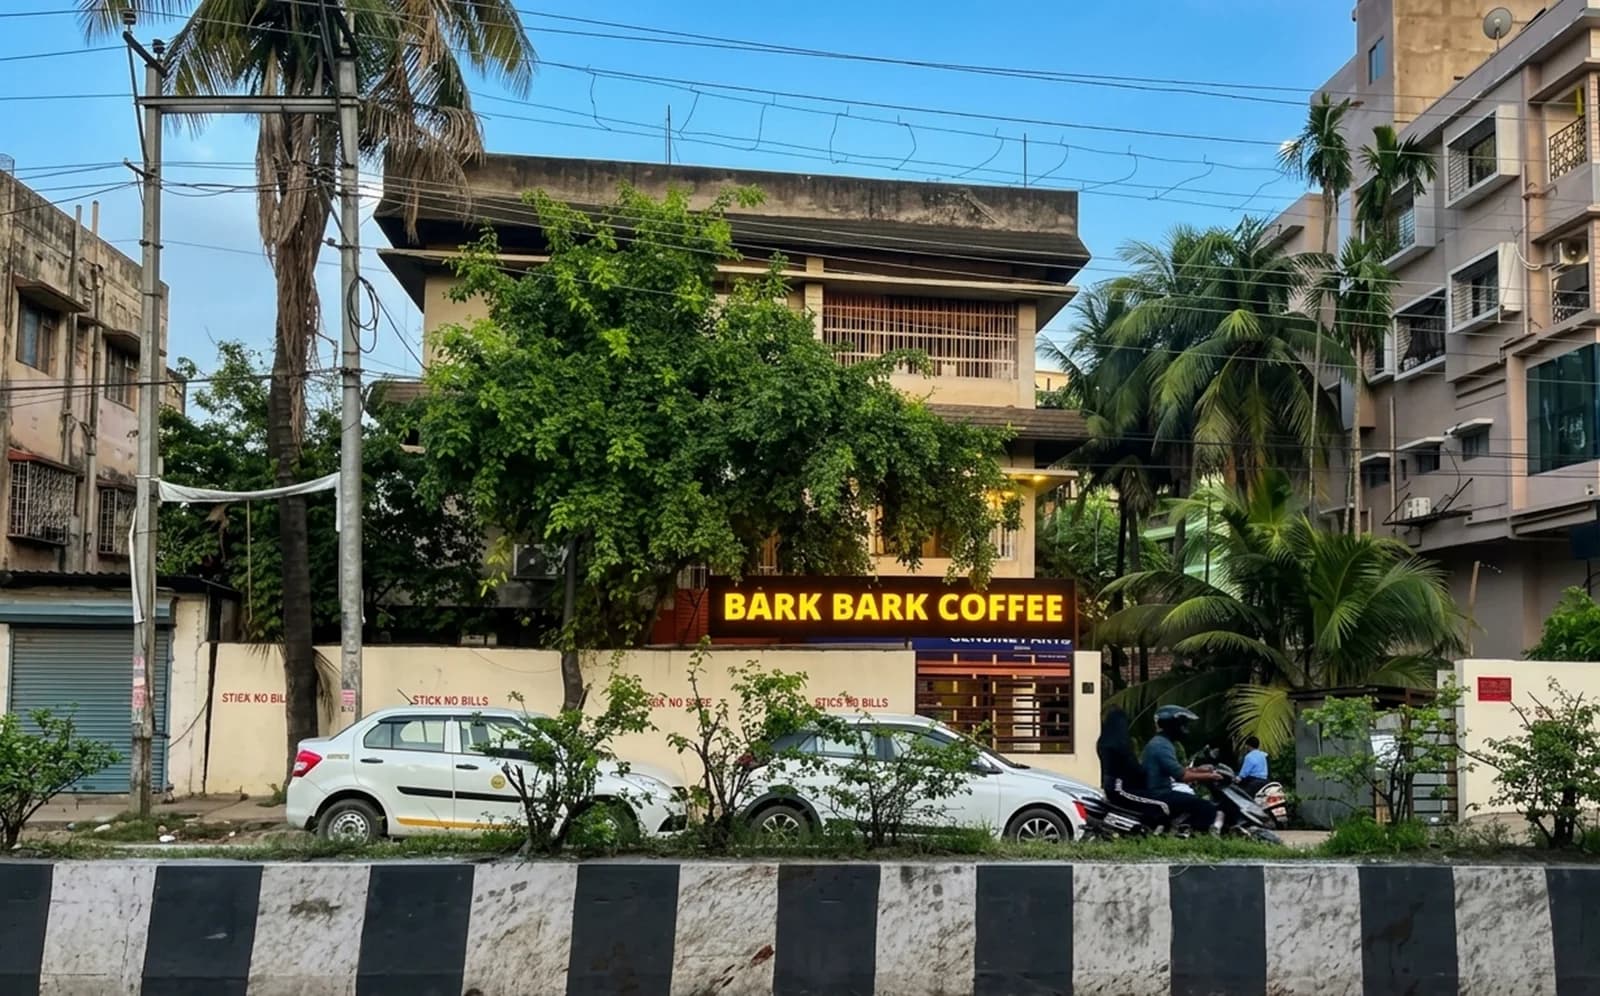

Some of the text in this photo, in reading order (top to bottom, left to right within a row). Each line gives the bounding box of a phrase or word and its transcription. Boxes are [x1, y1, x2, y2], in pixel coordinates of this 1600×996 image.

[725, 593, 1063, 622] BARK BARK COFFEE
[270, 693, 288, 704] BIL
[412, 695, 489, 706] STICK NO BILLS
[862, 697, 889, 708] BILLS
